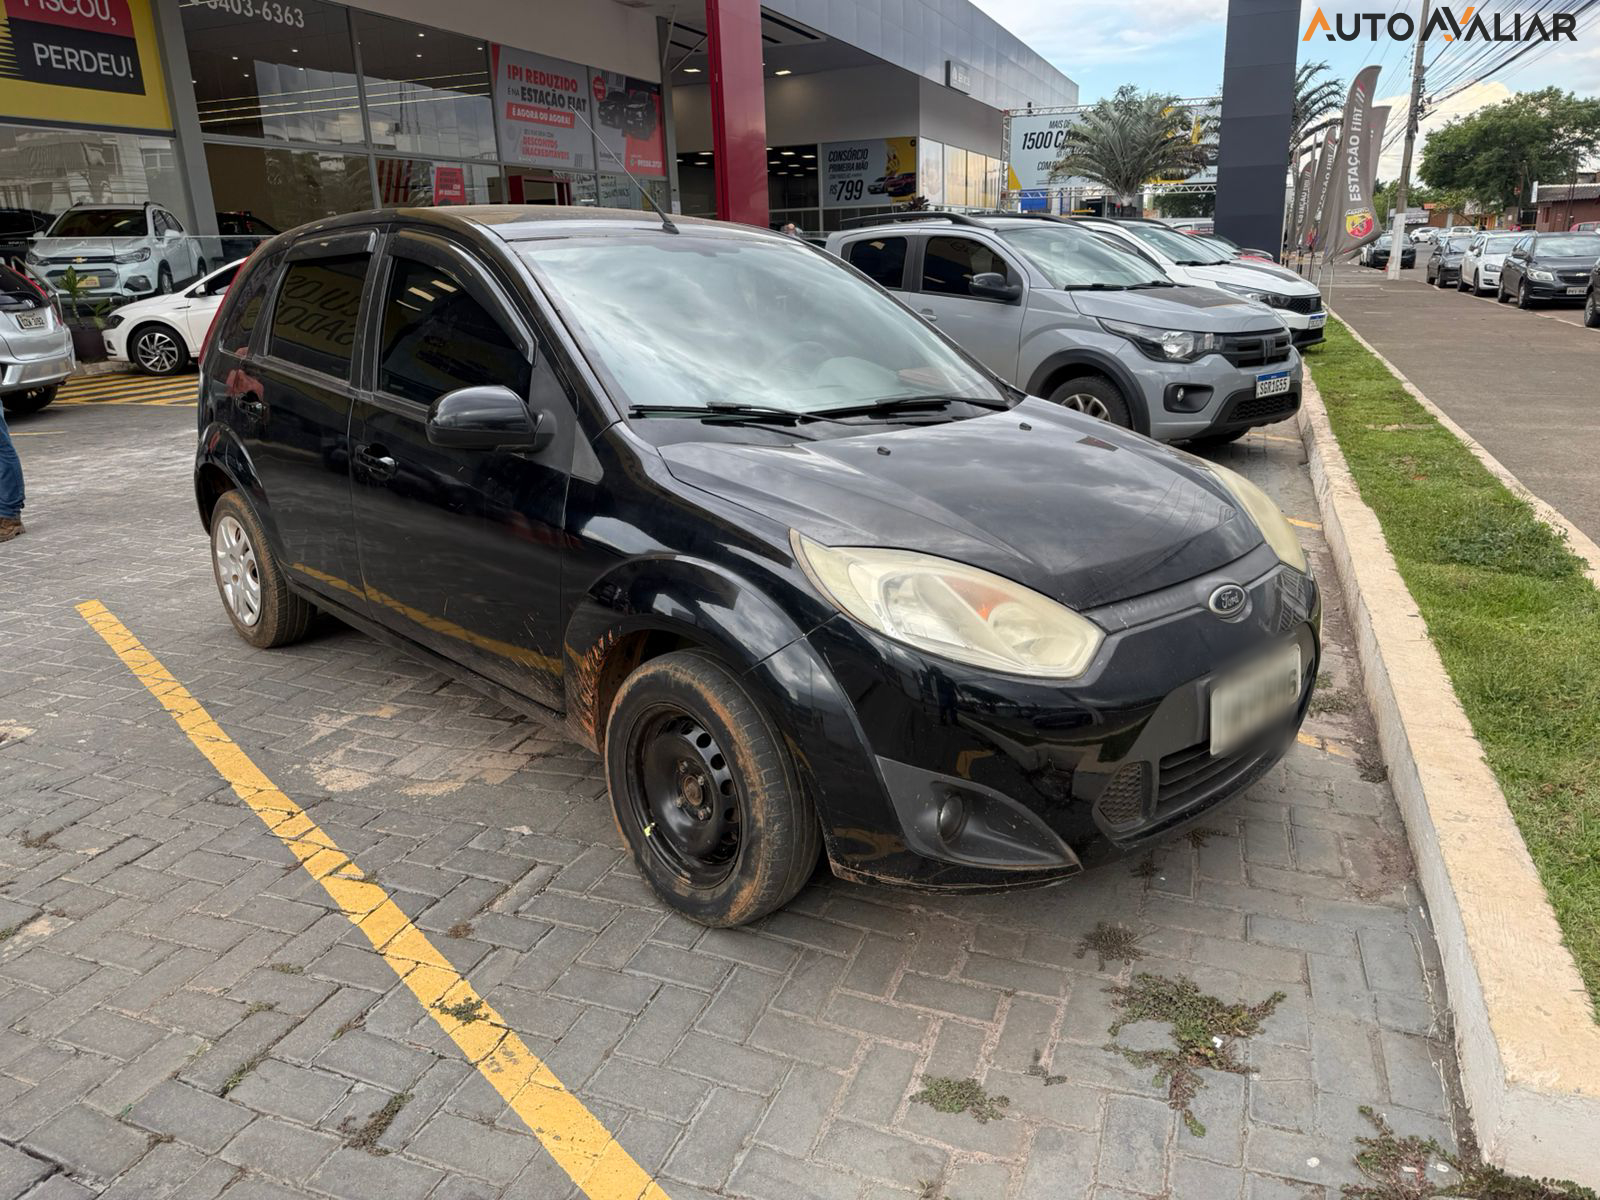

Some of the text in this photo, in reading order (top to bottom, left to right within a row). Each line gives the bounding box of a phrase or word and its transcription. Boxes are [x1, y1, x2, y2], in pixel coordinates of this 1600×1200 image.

[32, 42, 134, 79] PERDEU!
[508, 64, 522, 81] IPI
[526, 68, 577, 93] REDUZIDO
[512, 88, 520, 96] NA
[521, 86, 565, 110] ESTAÇÃO
[568, 96, 586, 112] FIAT
[517, 107, 538, 119] AGORA
[539, 112, 548, 121] OU
[1351, 107, 1364, 131] FIAT
[1048, 120, 1063, 129] MAIS
[1022, 131, 1052, 150] 1500
[828, 147, 868, 162] CONSÓRCIO
[828, 161, 868, 172] PRIMEIRA MÃO
[1037, 161, 1052, 171] COM
[1347, 134, 1362, 202] ESTAÇÃO
[836, 180, 864, 202] 799
[1220, 590, 1240, 609] Ford
